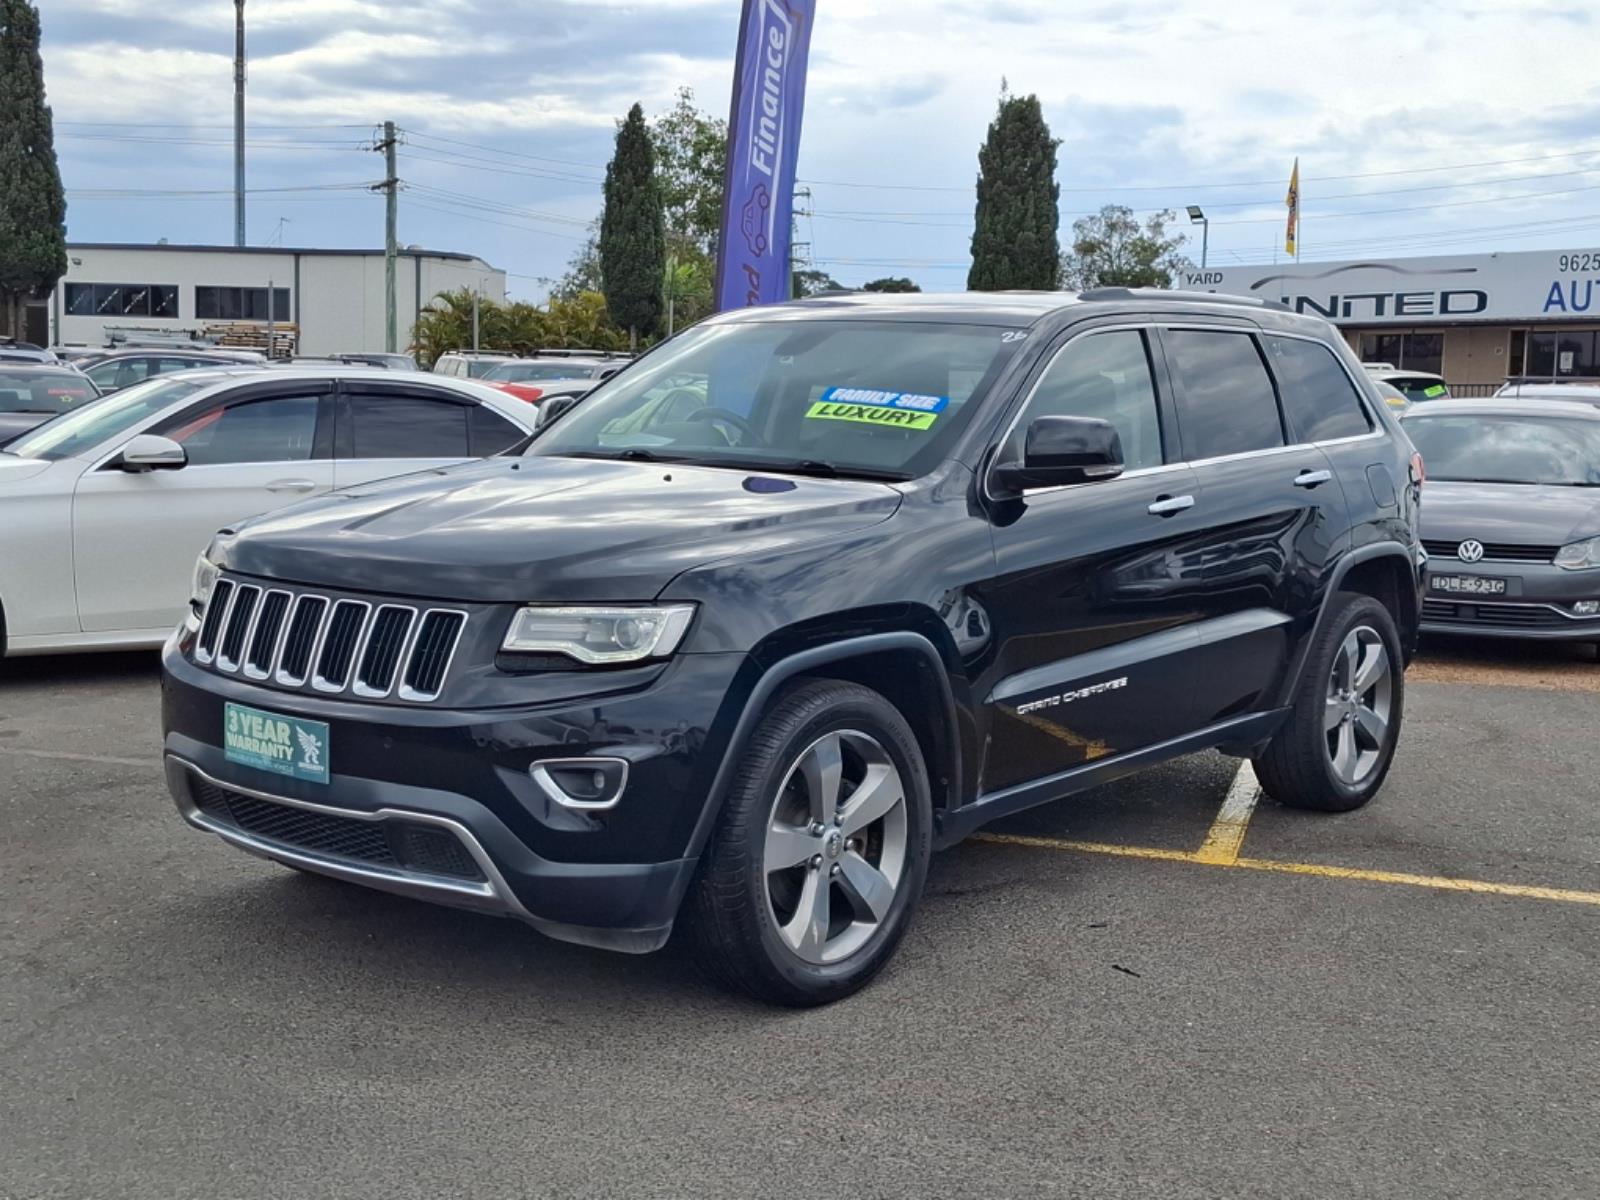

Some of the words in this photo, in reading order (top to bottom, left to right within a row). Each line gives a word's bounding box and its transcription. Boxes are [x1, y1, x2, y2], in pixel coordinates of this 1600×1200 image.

[752, 25, 784, 176] Finance
[1560, 253, 1600, 272] 9625
[1186, 272, 1223, 285] YARD
[1281, 290, 1488, 318] NITED
[1543, 280, 1600, 313] AU
[829, 388, 899, 405] FAMILY
[895, 393, 940, 410] SIZE
[816, 404, 924, 424] LUXURY
[229, 710, 238, 732] 3
[240, 713, 291, 746] YEAR
[226, 733, 294, 761] WARRANTY
